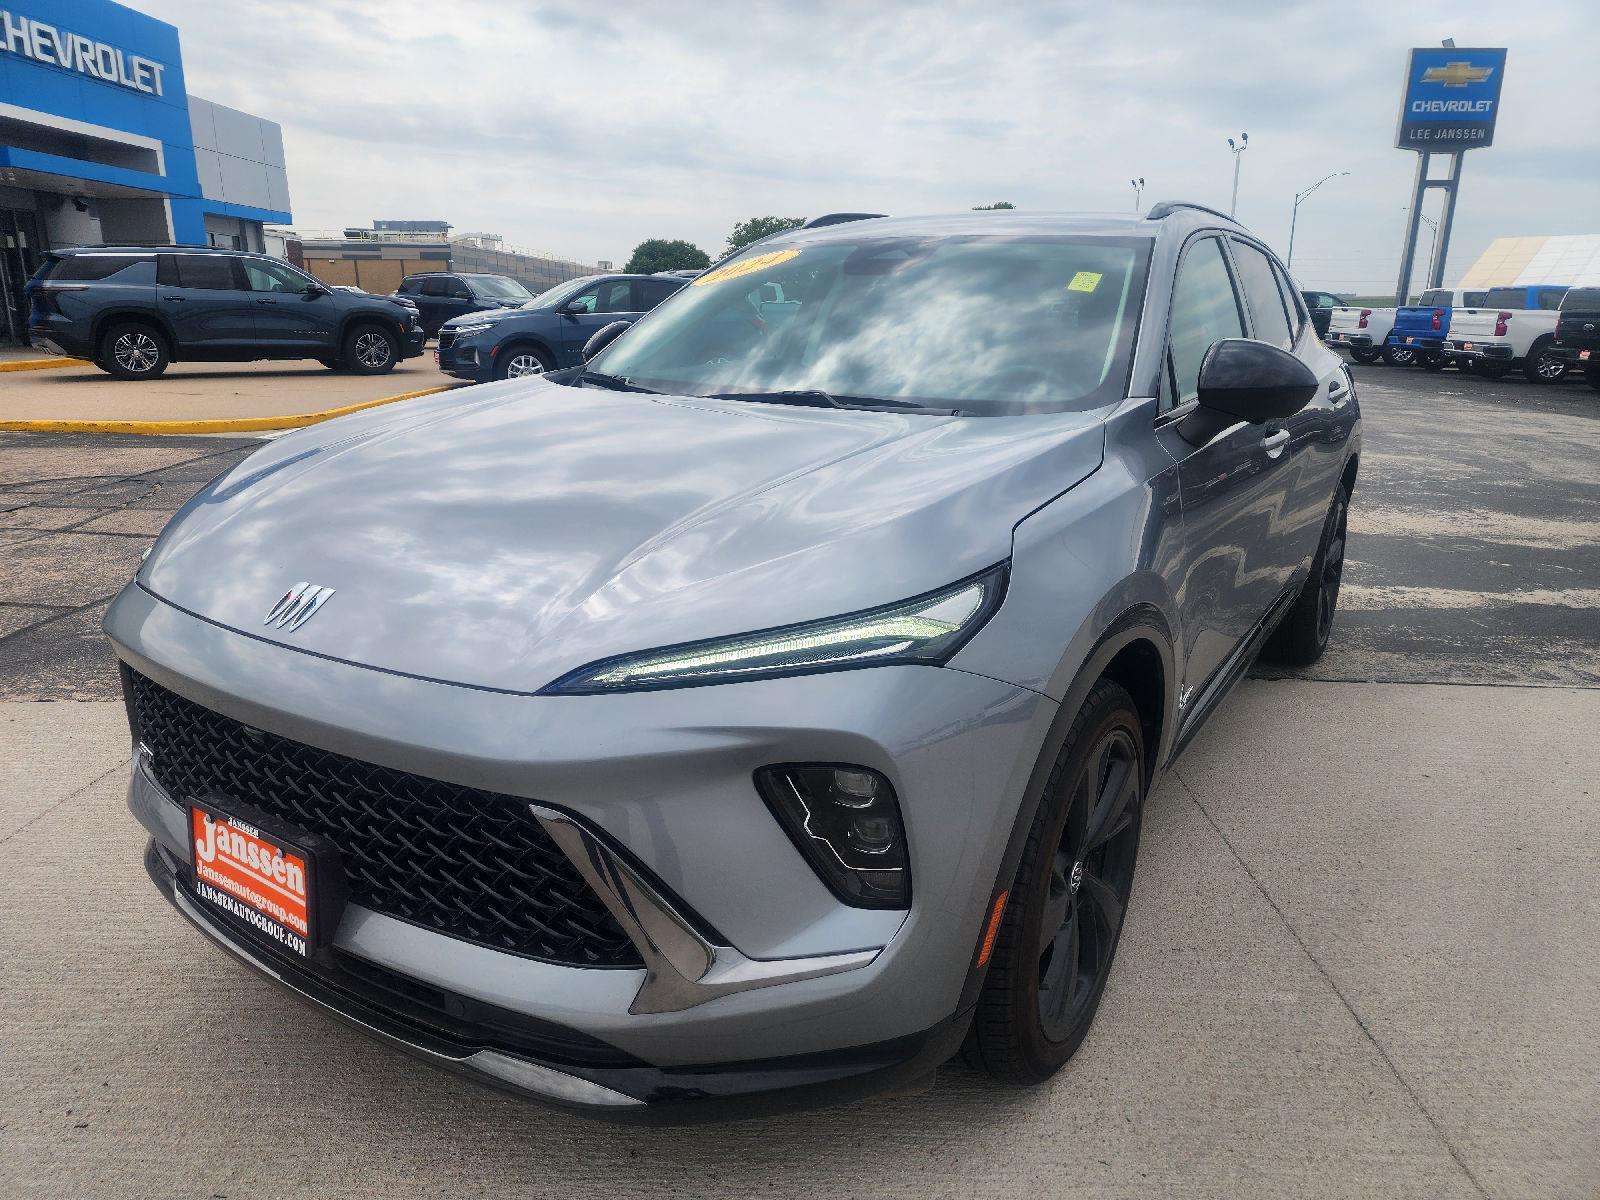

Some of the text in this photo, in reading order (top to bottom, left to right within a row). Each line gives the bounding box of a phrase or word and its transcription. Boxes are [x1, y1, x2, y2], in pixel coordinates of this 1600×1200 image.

[0, 10, 164, 96] HEVROLET
[1409, 128, 1486, 140] LEE JANSSEN
[1411, 100, 1493, 113] CHEVROLET
[196, 813, 305, 896] Janssen
[227, 816, 259, 838] JANSSEN
[196, 859, 308, 935] Janssenautogroup.com
[196, 881, 306, 957] JANSSENAUTOGROUP.COM
